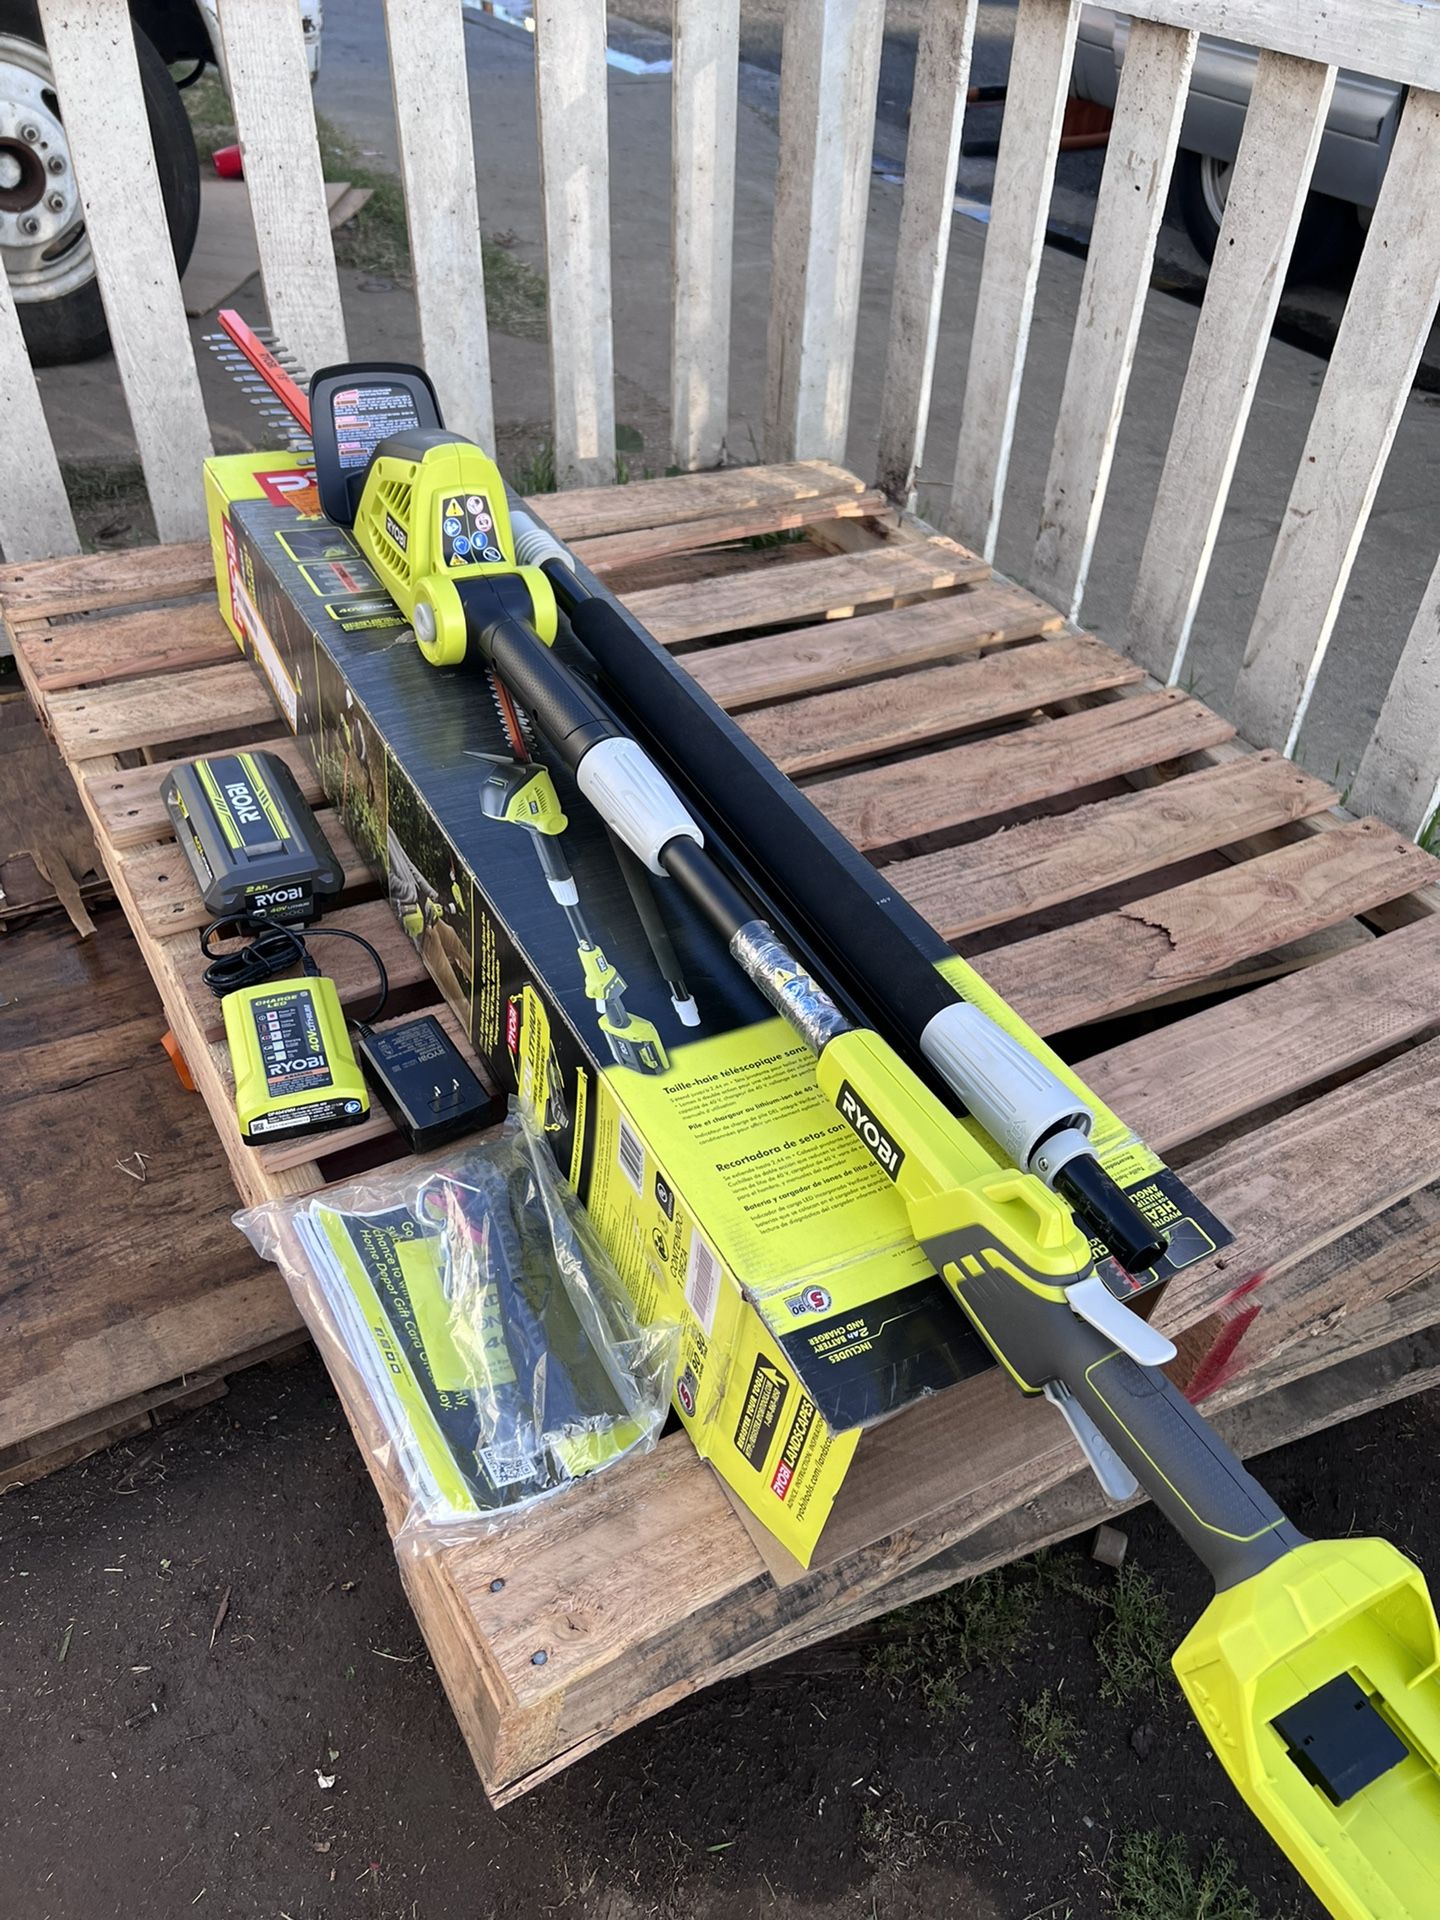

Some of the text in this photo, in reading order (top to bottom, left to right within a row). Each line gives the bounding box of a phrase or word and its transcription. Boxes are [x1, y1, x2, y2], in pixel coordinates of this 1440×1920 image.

[386, 517, 406, 547] RYOBI
[224, 782, 262, 824] RYOBI
[255, 887, 303, 907] RYOBI
[269, 905, 288, 913] 40V
[255, 994, 298, 1006] CHARGE
[267, 1001, 288, 1009] LED
[303, 1004, 320, 1052] 40V LITHIUM
[508, 1006, 519, 1049] RYOBI
[528, 994, 538, 1066] LITHIUM
[268, 1055, 325, 1076] RYOBI
[418, 1047, 446, 1064] RYOBI
[663, 1045, 808, 1095] Taille-haie téléscopique sans
[688, 1123, 703, 1131] Pile
[712, 1109, 744, 1124] chargeur
[755, 1093, 794, 1110] lithium-ion
[804, 1086, 813, 1094] 40
[715, 1123, 846, 1172] Recortadora de setos con
[843, 1091, 898, 1172] RYOBI
[778, 1185, 812, 1200] cargador
[822, 1173, 843, 1184] iones
[843, 1169, 853, 1177] de
[1151, 1210, 1183, 1229] PIVOTIN
[373, 1228, 395, 1263] chance
[391, 1265, 402, 1278] to
[670, 1212, 685, 1278] CONTENIDO:
[1091, 1244, 1110, 1260] CU
[678, 1247, 689, 1281] PIEZA
[359, 1229, 379, 1258] Home
[375, 1258, 397, 1297] Depot
[392, 1296, 407, 1320] Gift
[403, 1319, 423, 1348] Card
[810, 1291, 825, 1308] 5
[791, 1303, 806, 1316] 90
[807, 1318, 865, 1346] AND CHARGER
[813, 1326, 869, 1354] 2Ah BATTERY
[828, 1340, 873, 1364] INCLUDES
[746, 1395, 758, 1417] YOUR
[752, 1370, 764, 1397] TOOLS
[772, 1399, 814, 1497] RYOBI LANDSCAPES
[795, 1437, 836, 1522] ryobitools.com/landsca
